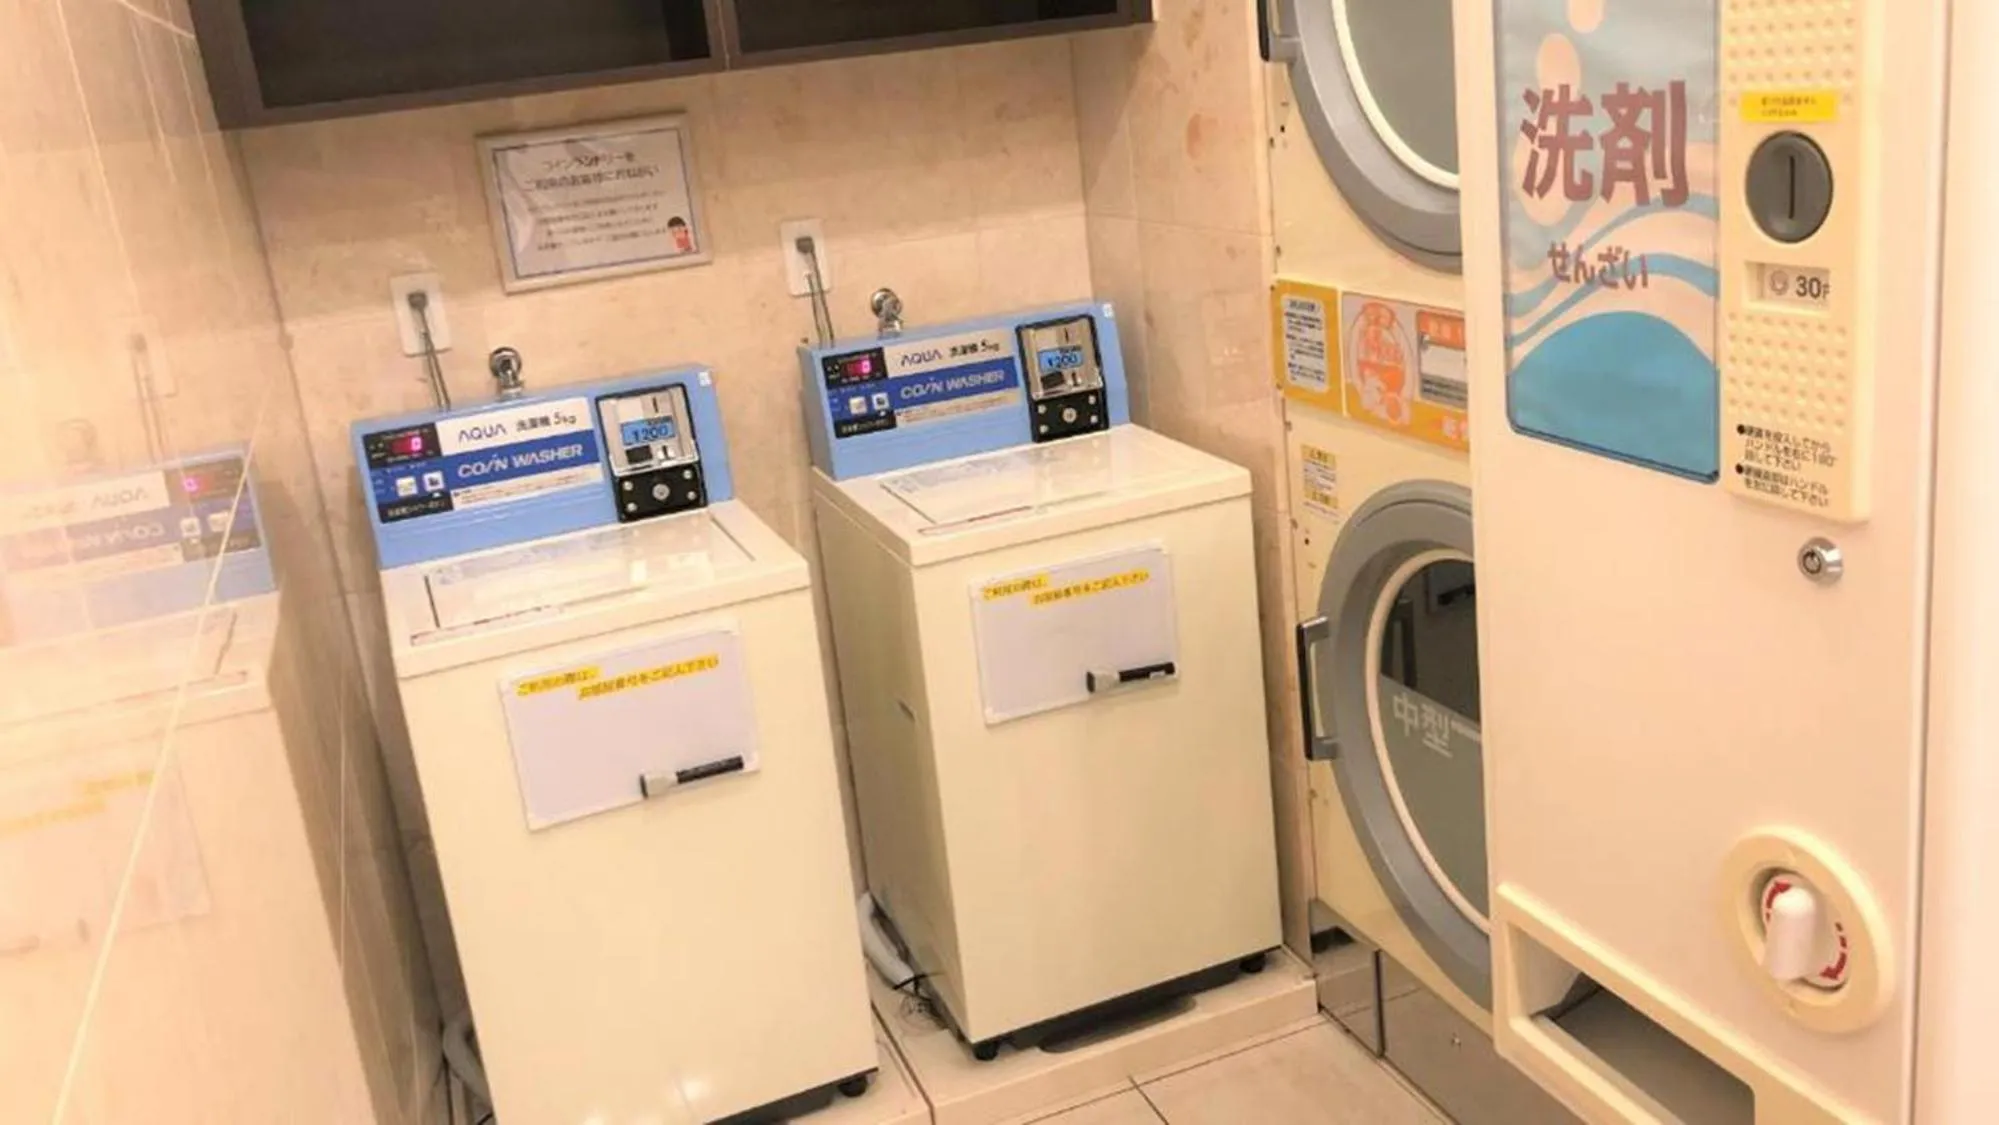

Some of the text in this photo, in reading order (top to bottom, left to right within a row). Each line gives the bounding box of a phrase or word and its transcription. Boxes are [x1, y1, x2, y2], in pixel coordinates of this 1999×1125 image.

[1521, 80, 1690, 208] 洗剤
[1547, 242, 1649, 290] せんざい
[900, 349, 942, 367] AQUA
[900, 377, 944, 399] COIN
[946, 370, 1005, 391] WASHER
[458, 423, 507, 442] AQUA
[458, 454, 509, 478] COIN
[512, 444, 583, 468] WASHER
[1393, 692, 1453, 758] 中型
